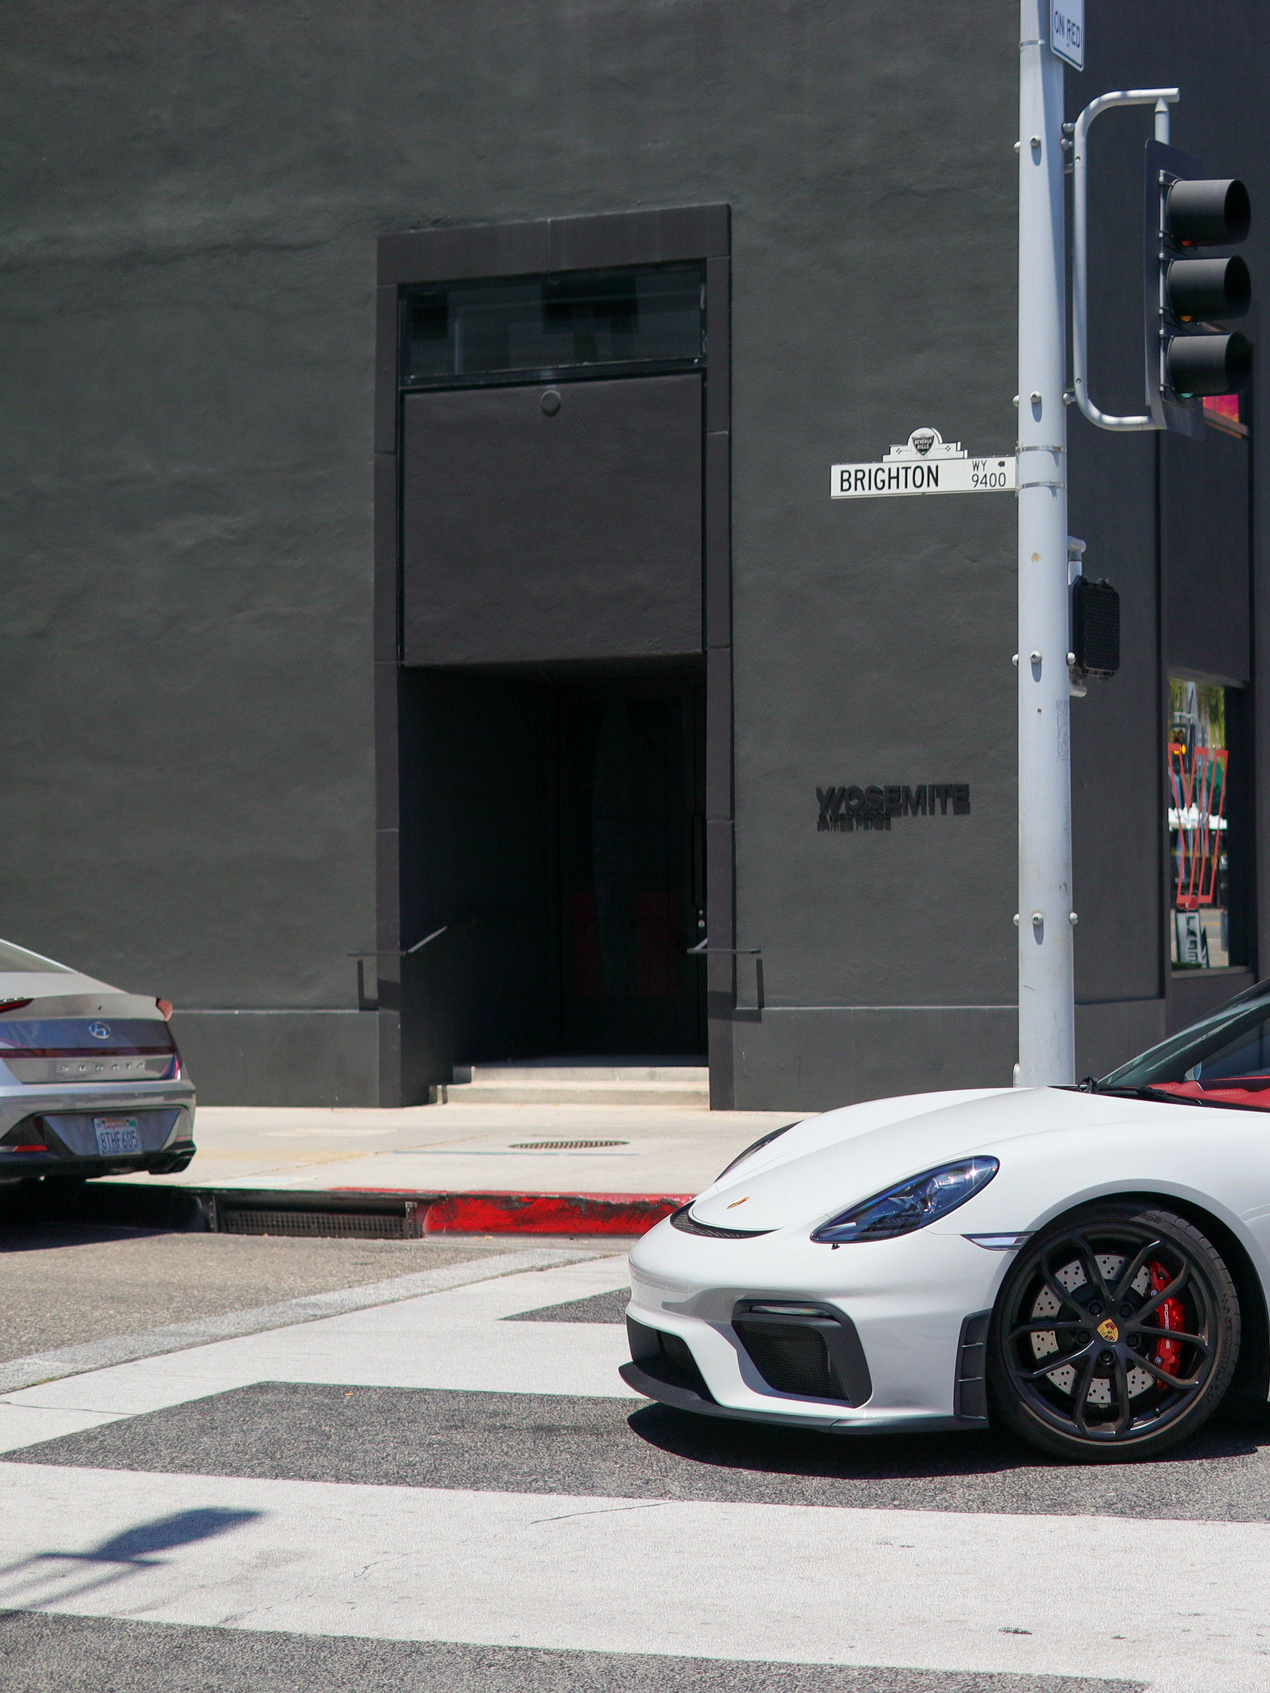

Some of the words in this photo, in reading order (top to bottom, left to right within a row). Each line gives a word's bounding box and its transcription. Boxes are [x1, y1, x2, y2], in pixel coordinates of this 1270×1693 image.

[840, 465, 939, 492] BRIGHTON
[971, 460, 987, 472] WY
[971, 473, 1006, 488] 9400
[816, 784, 971, 814] YOSEMITE
